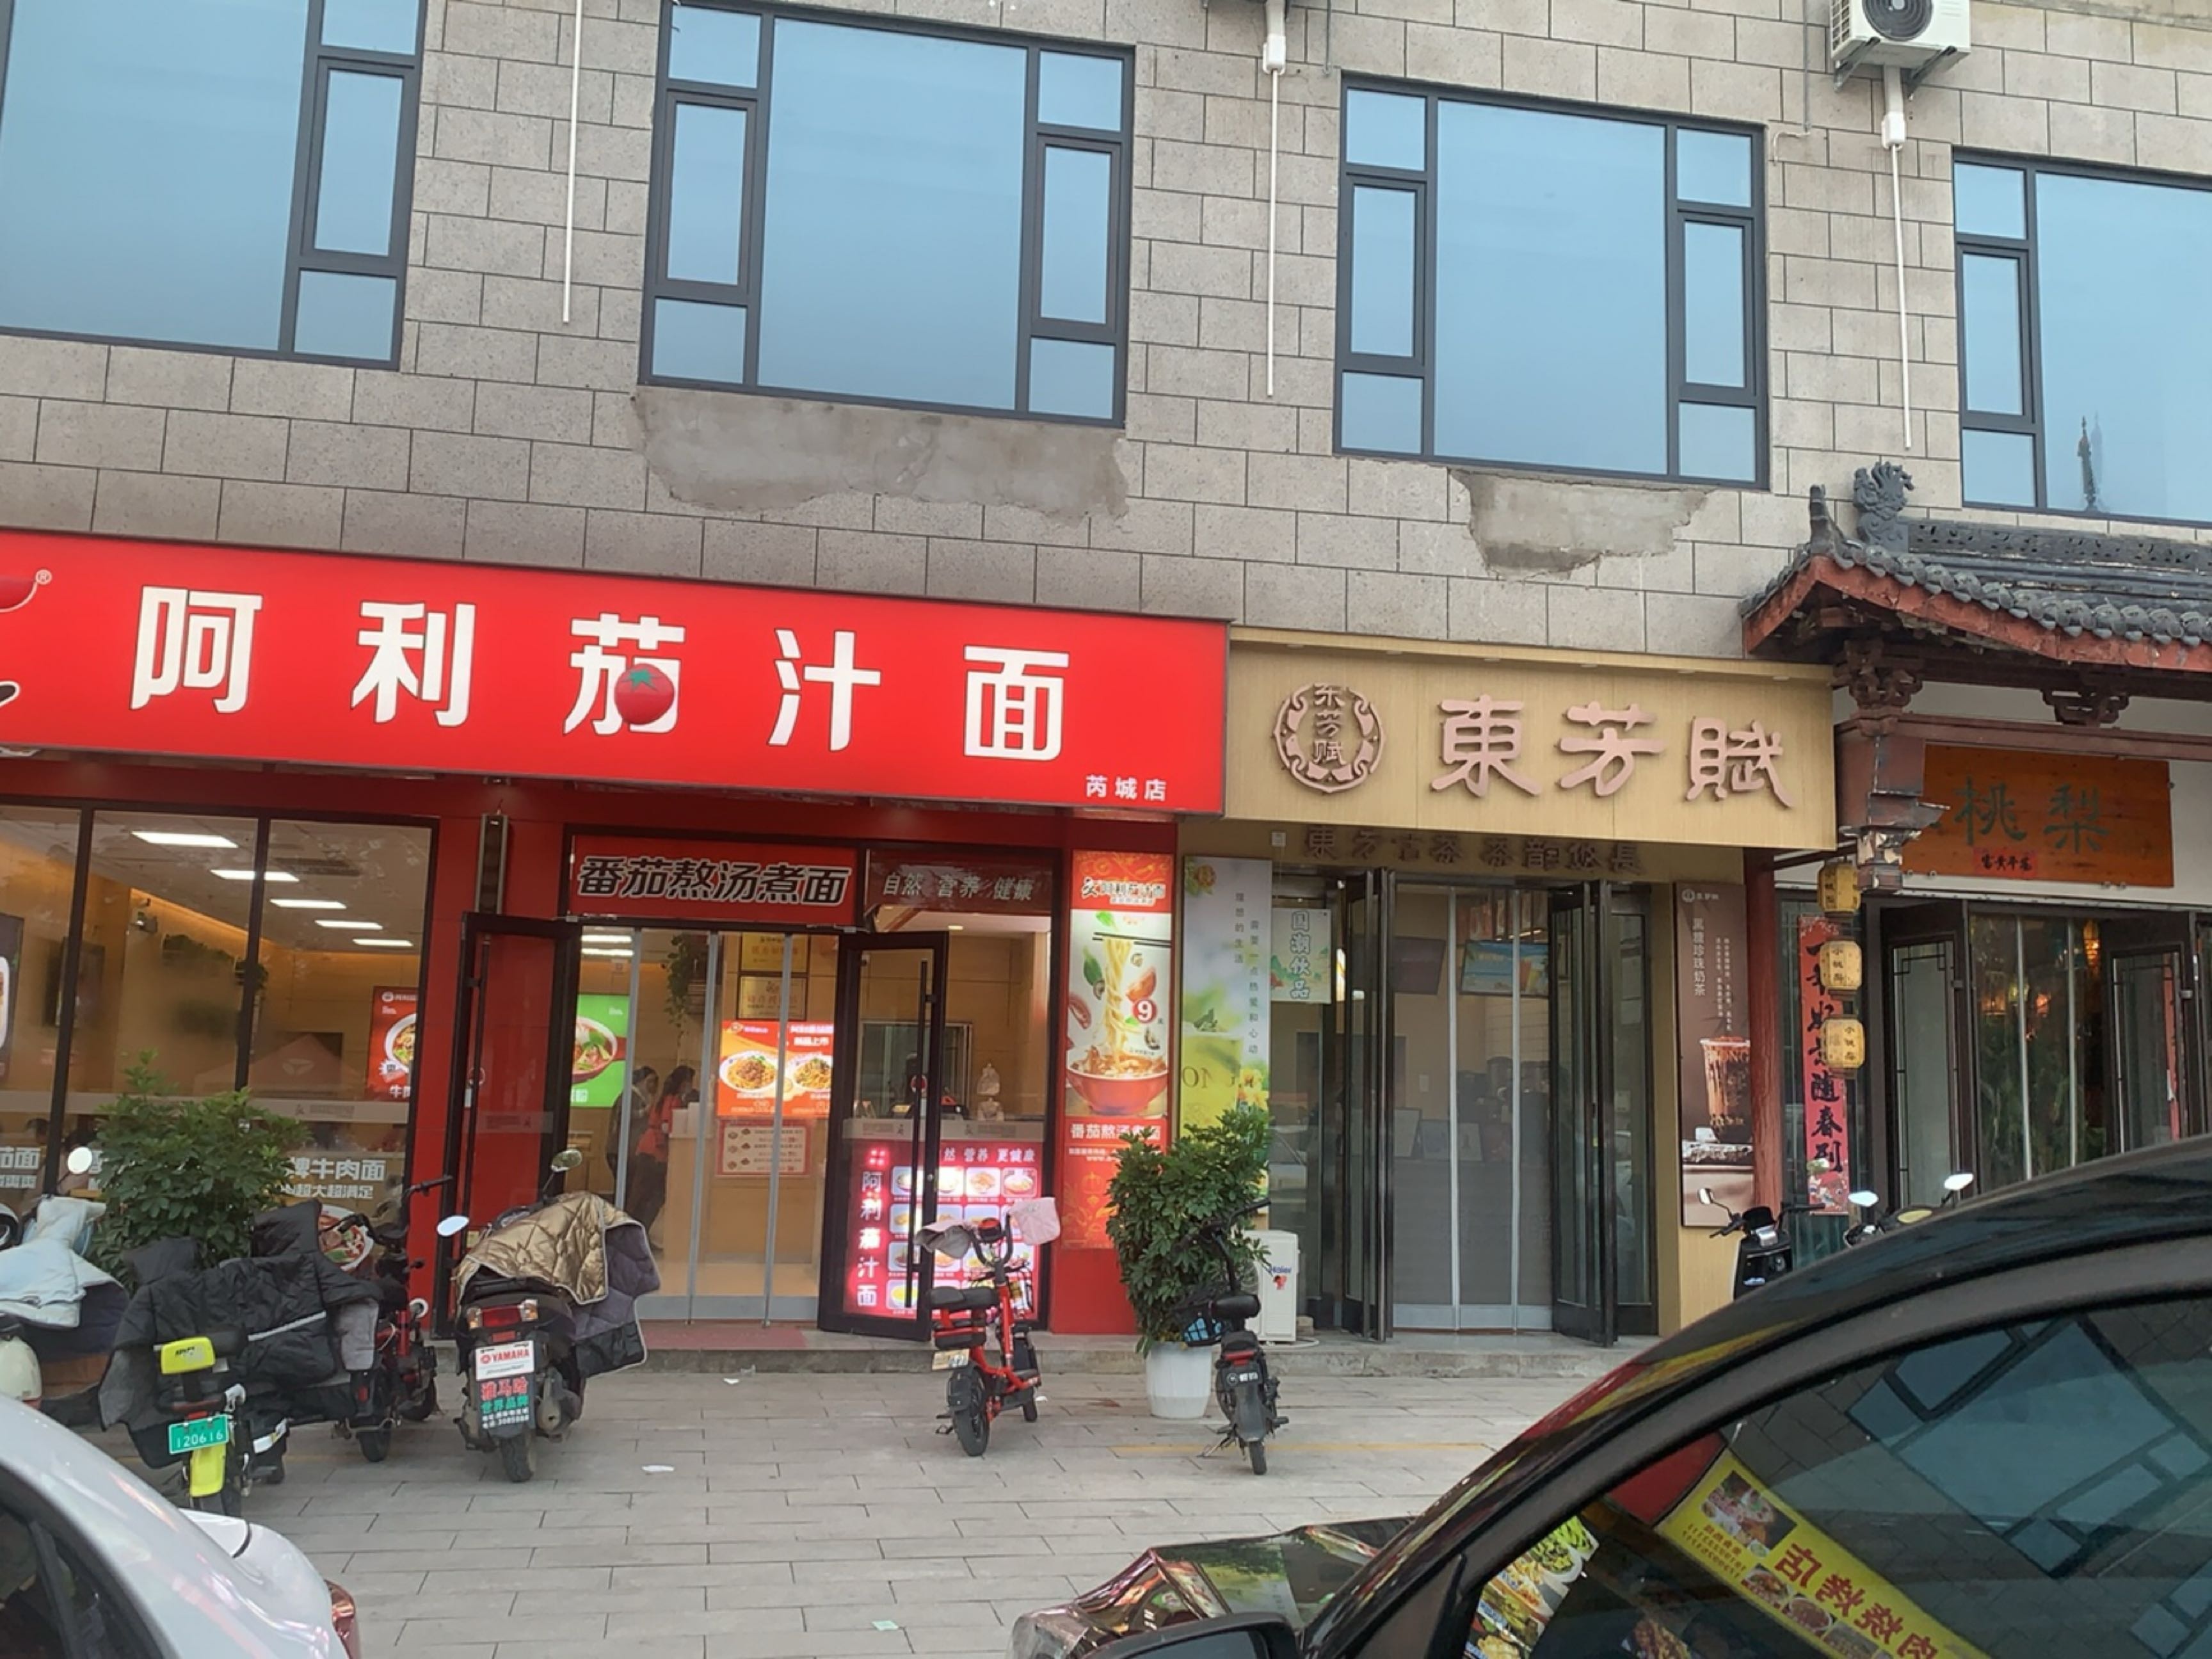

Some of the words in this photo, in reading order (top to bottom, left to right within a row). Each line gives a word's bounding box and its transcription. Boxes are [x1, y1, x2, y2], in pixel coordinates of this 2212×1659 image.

[130, 585, 1070, 762] 阿利茄汁面
[1085, 774, 1167, 801] 芮城店
[577, 855, 851, 906] 番茄熬汤煮面
[883, 872, 923, 895] 自然
[938, 874, 981, 898] 营养
[993, 876, 1036, 901] 健康
[287, 1156, 387, 1182] 牌牛肉面
[491, 1348, 530, 1361] YAMAHA
[176, 1429, 223, 1448] 120616
